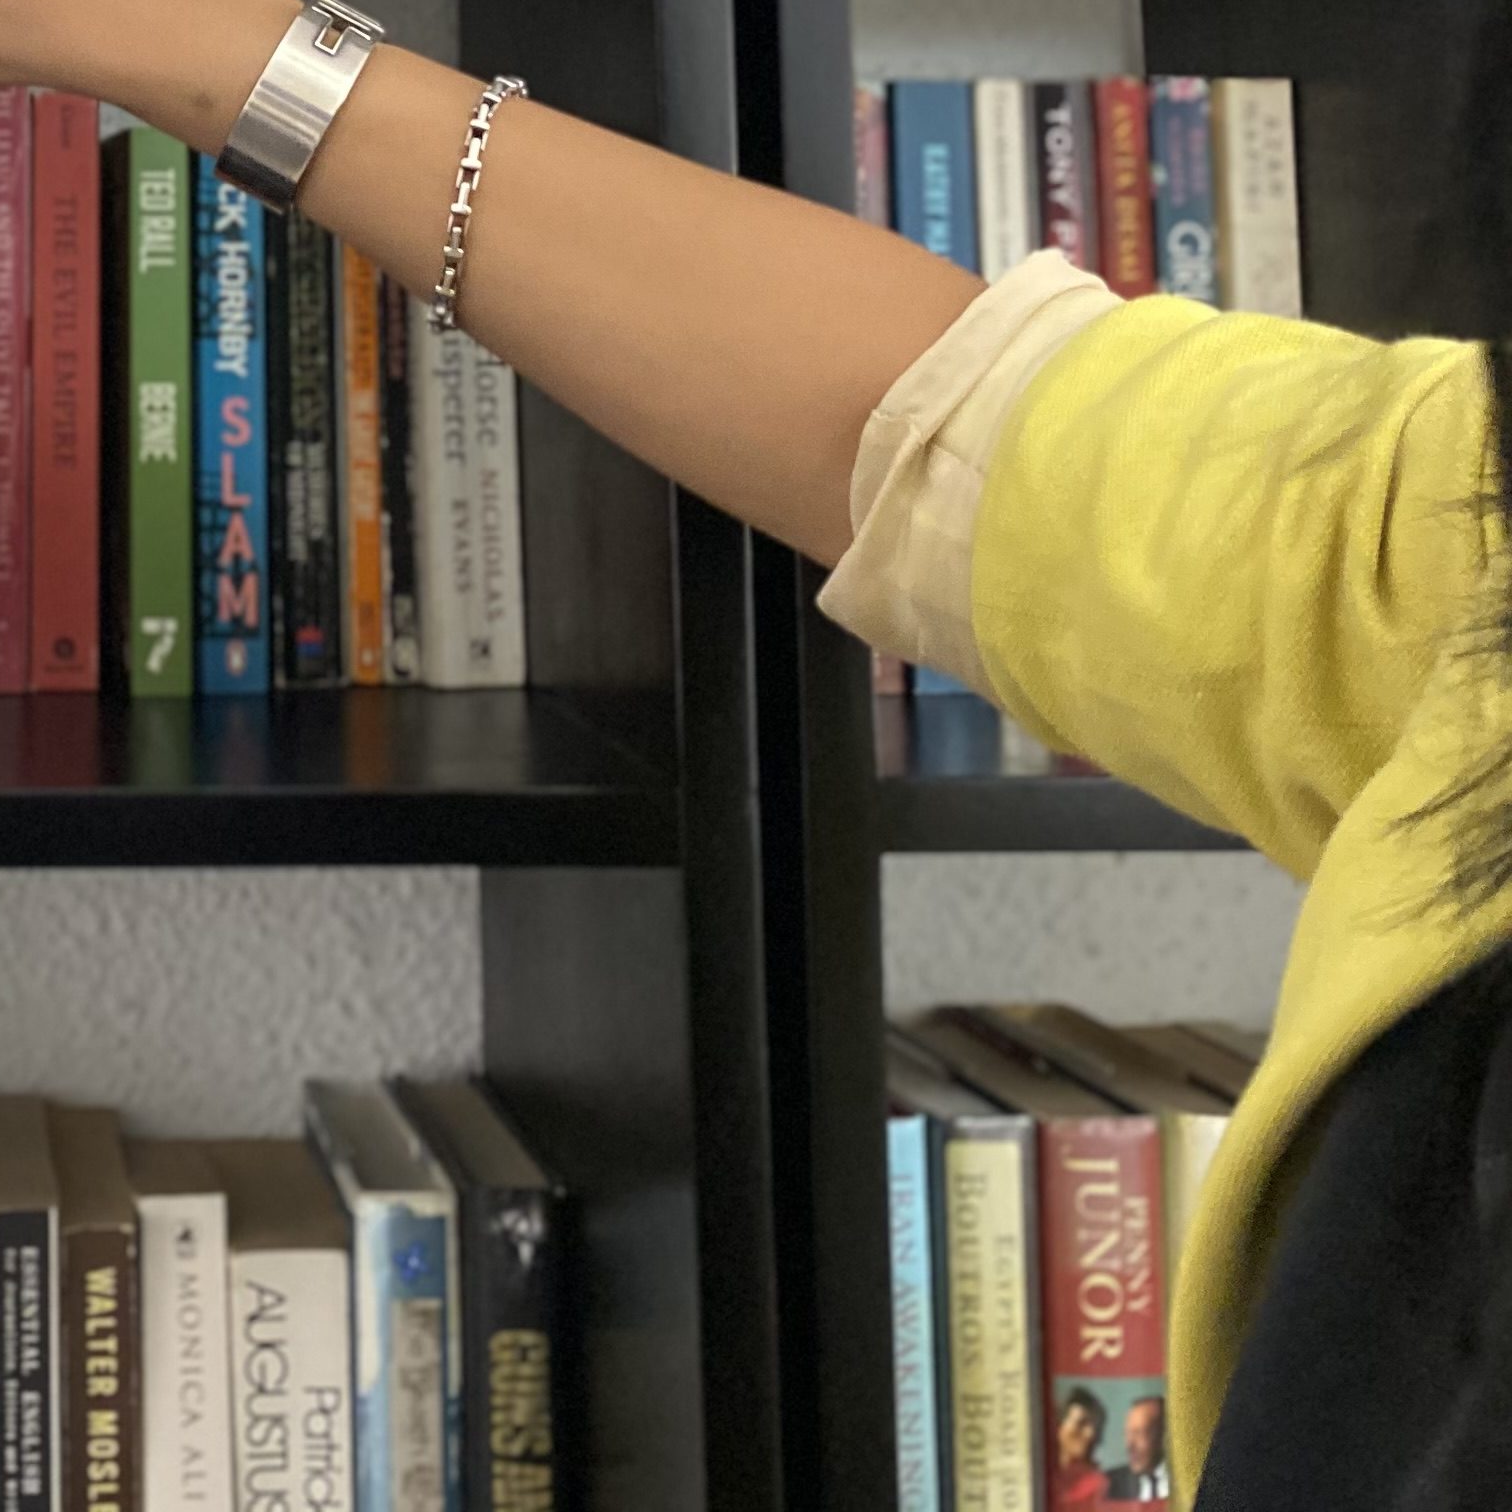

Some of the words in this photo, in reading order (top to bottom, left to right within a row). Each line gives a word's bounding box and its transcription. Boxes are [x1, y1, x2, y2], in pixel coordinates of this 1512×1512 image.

[140, 168, 176, 211] TED
[215, 183, 248, 230] CK
[1045, 103, 1080, 214] TONY
[51, 194, 79, 256] THE
[139, 216, 176, 272] RALL
[52, 268, 79, 342] EVIL
[214, 241, 250, 378] HORNBY
[51, 350, 78, 470] EMPIRE
[215, 396, 260, 628] SLAM
[449, 498, 473, 596] EVANS
[477, 466, 506, 625] NICHOLAS
[888, 1172, 917, 1266] IRAN
[951, 1172, 990, 1369] BOUTROS
[1060, 1144, 1125, 1363] JUNOR
[1124, 1196, 1153, 1318] PENNY
[20, 1245, 41, 1376] ESSENTIAL
[85, 1266, 119, 1398] WALTER
[177, 1272, 205, 1429] MONICA
[20, 1390, 41, 1495] ENGLISH
[486, 1329, 551, 1456] GUNS
[996, 1370, 1022, 1458] ROAD
[181, 1444, 207, 1501] ALI
